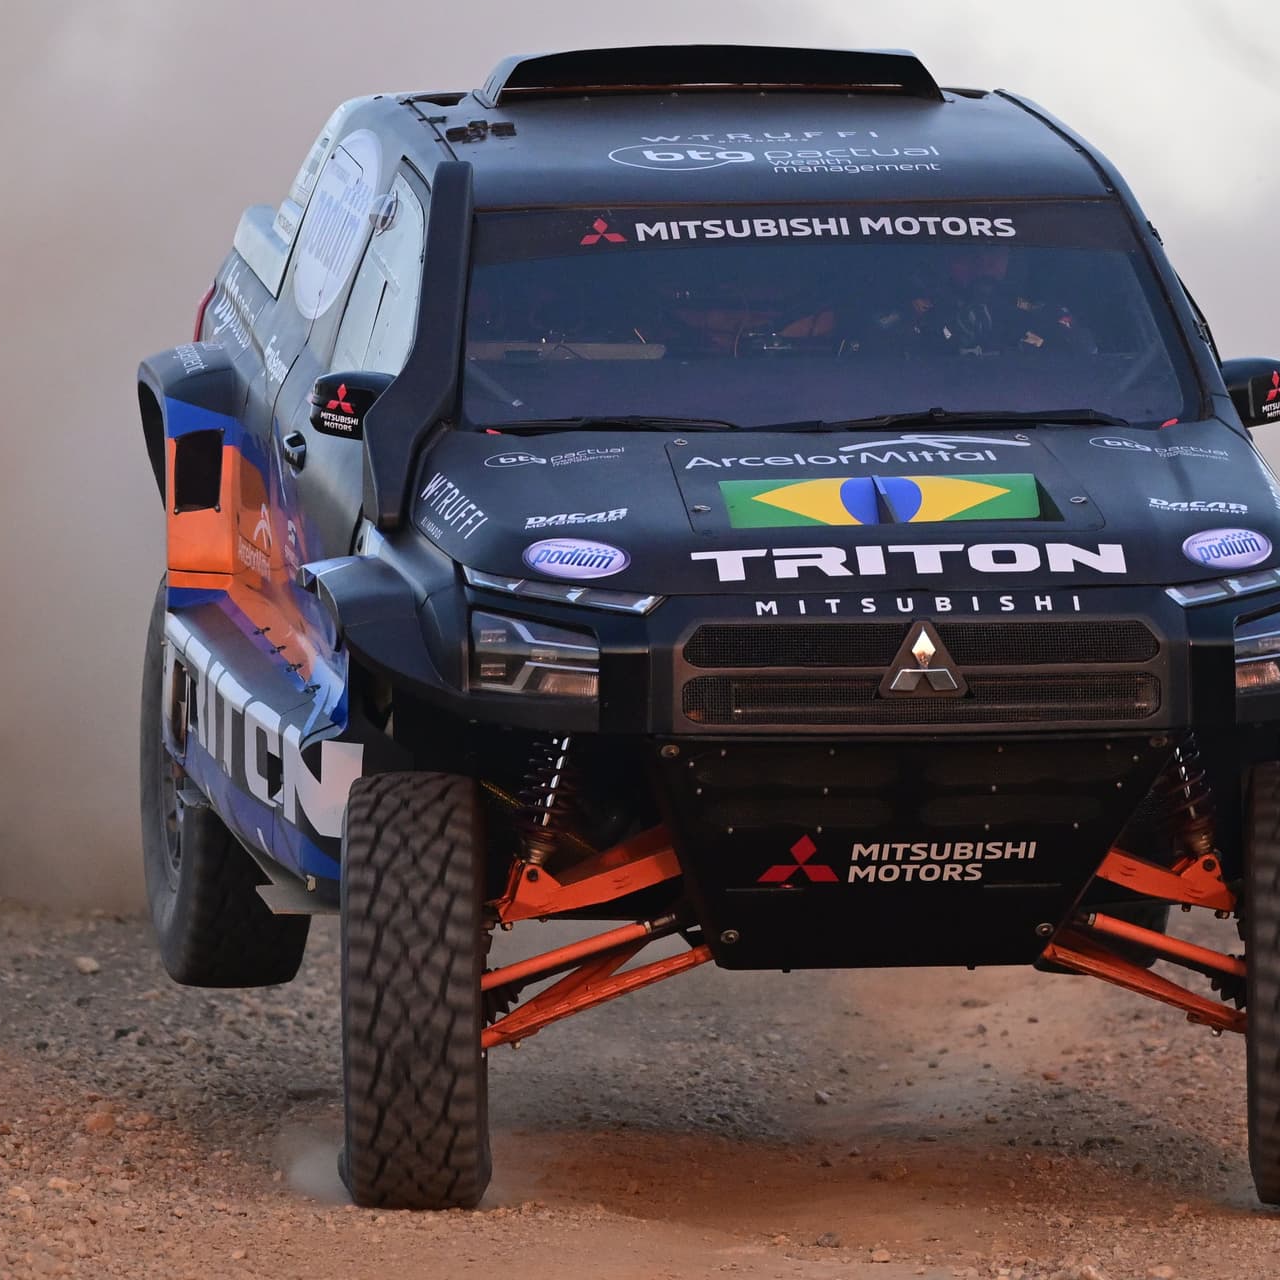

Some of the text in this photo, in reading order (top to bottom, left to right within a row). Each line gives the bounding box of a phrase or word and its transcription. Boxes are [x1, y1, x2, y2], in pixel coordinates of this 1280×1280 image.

[642, 145, 941, 163] btg pactual
[768, 157, 853, 167] wealth
[772, 162, 942, 174] management
[634, 216, 1017, 242] MITSUBISHI MOTORS
[320, 411, 359, 426] MITSUBISHI
[323, 420, 353, 432] MOTORS
[550, 447, 625, 465] pactual
[684, 449, 997, 470] ArcelorMittal
[1147, 496, 1248, 511] DACAR
[532, 547, 615, 570] podium
[1196, 536, 1262, 565] podium
[690, 543, 1128, 582] TRITON
[755, 594, 1081, 617] MITSUBISHI
[851, 841, 1037, 861] MITSUBISHI
[847, 863, 983, 883] MOTORS
